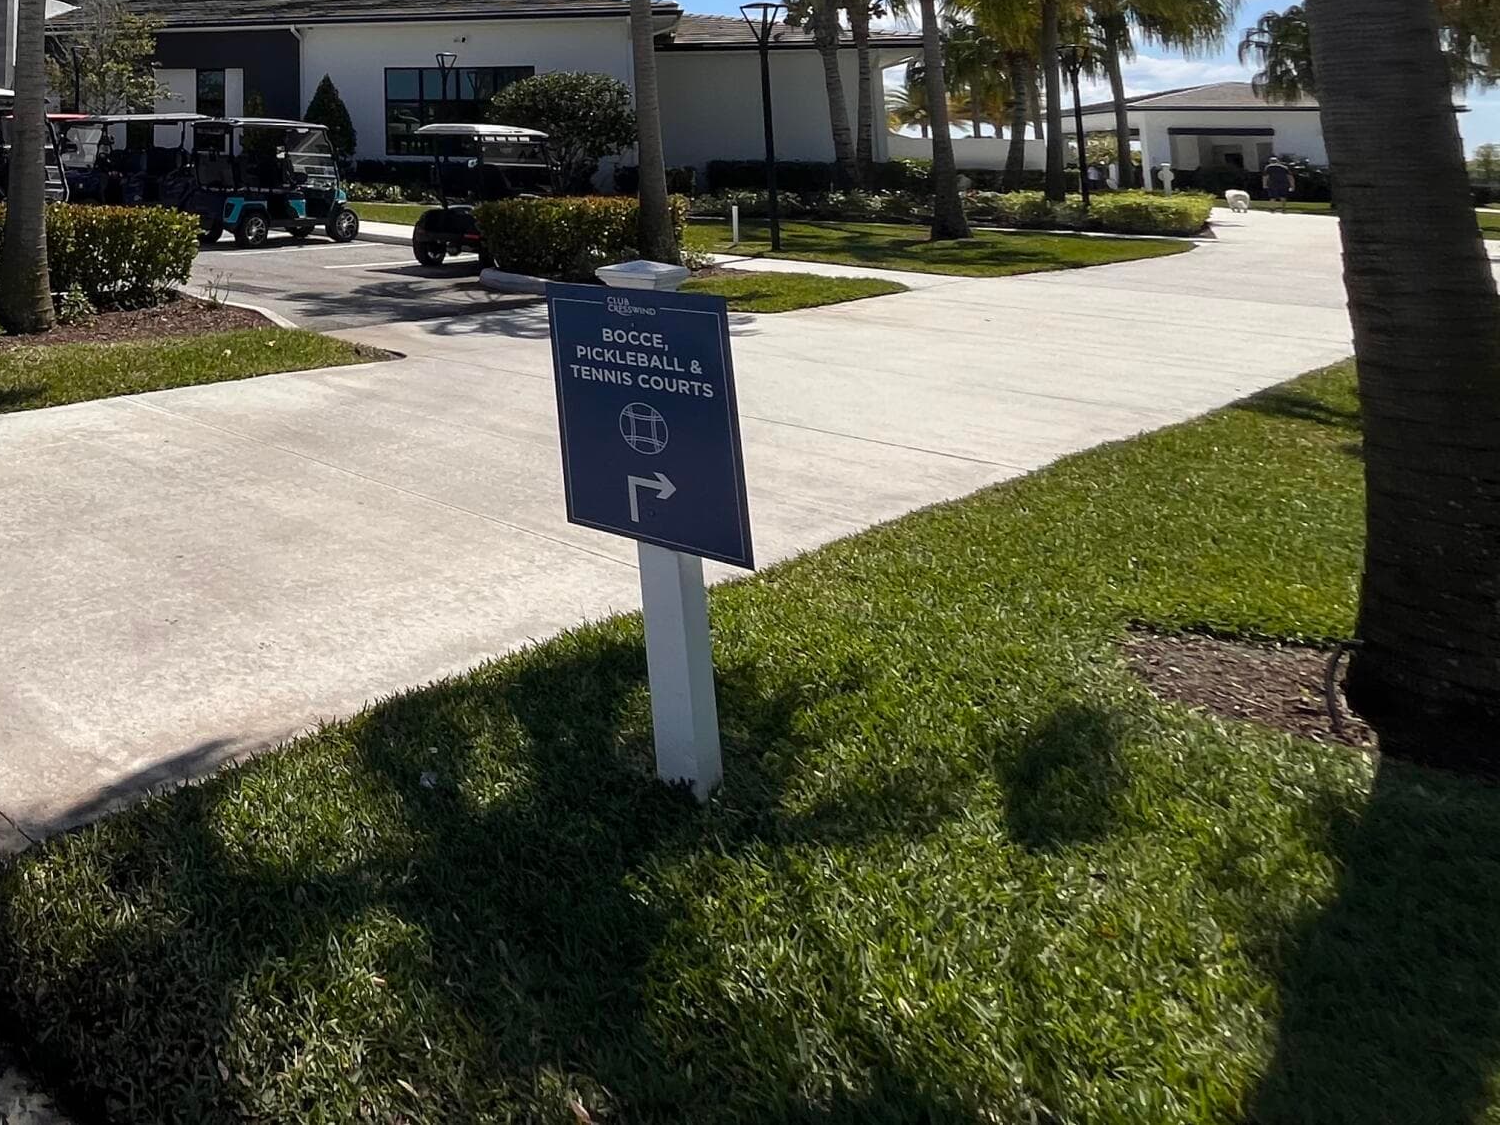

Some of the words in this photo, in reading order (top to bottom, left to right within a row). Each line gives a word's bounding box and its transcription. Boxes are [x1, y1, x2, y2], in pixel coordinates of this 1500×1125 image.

[606, 296, 630, 306] CLUB
[607, 304, 657, 316] CRESSWIND
[602, 328, 669, 351] BOCCE,
[576, 345, 685, 372] PICKLEBALL
[690, 359, 703, 375] &
[570, 364, 633, 386] TENNIS
[637, 374, 714, 398] COURTS
